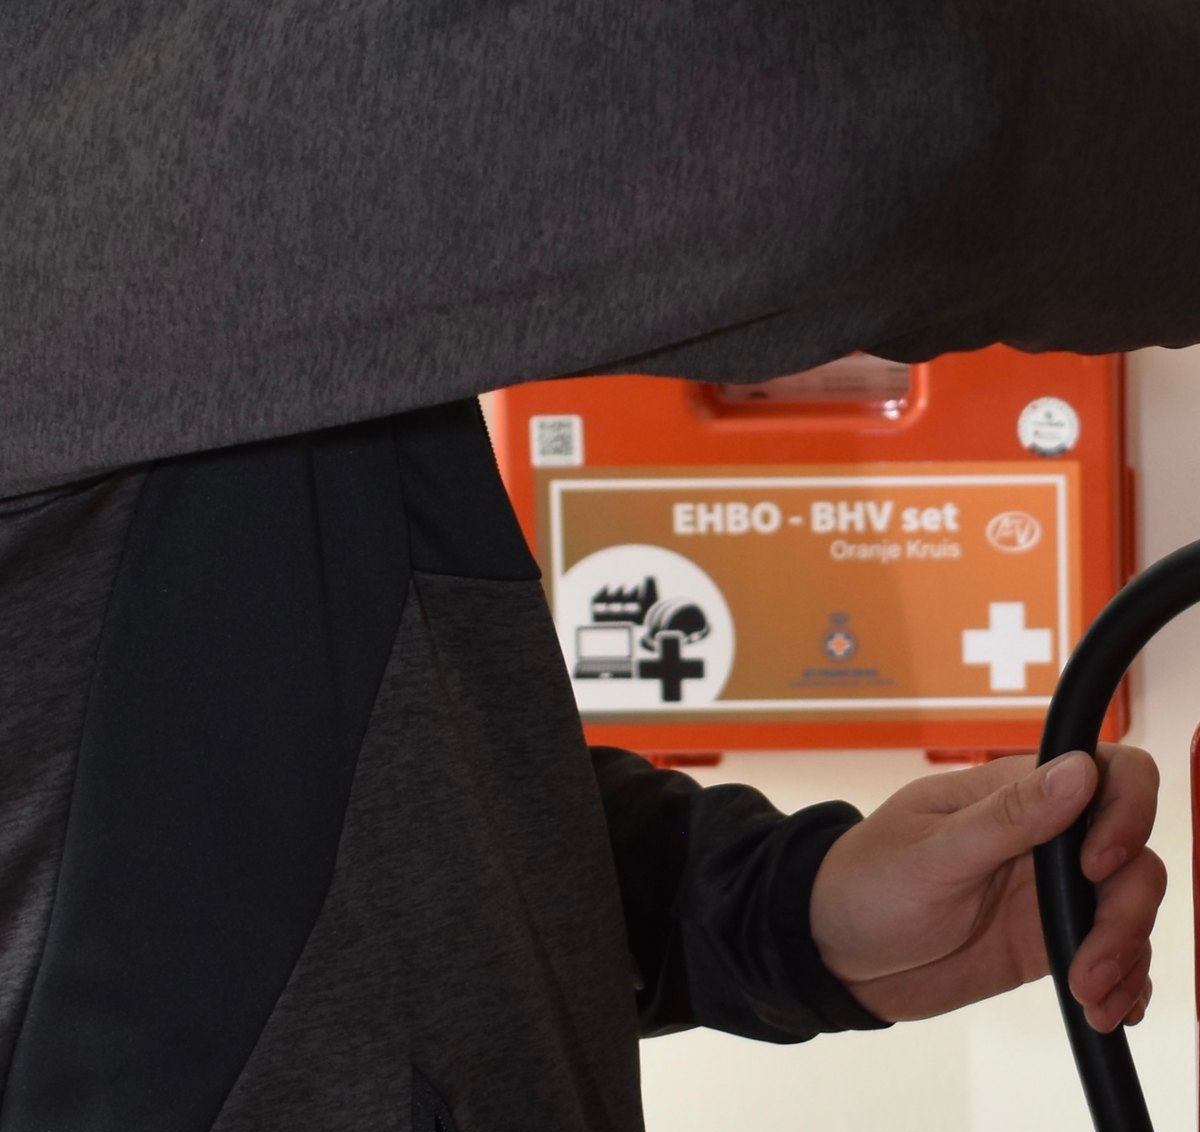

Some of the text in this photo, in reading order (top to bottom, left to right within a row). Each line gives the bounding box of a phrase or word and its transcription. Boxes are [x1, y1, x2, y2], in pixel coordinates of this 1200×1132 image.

[672, 501, 782, 535] EHBO
[810, 500, 893, 533] BHV
[901, 502, 959, 532] set
[829, 538, 962, 562] Oranje Kruis
